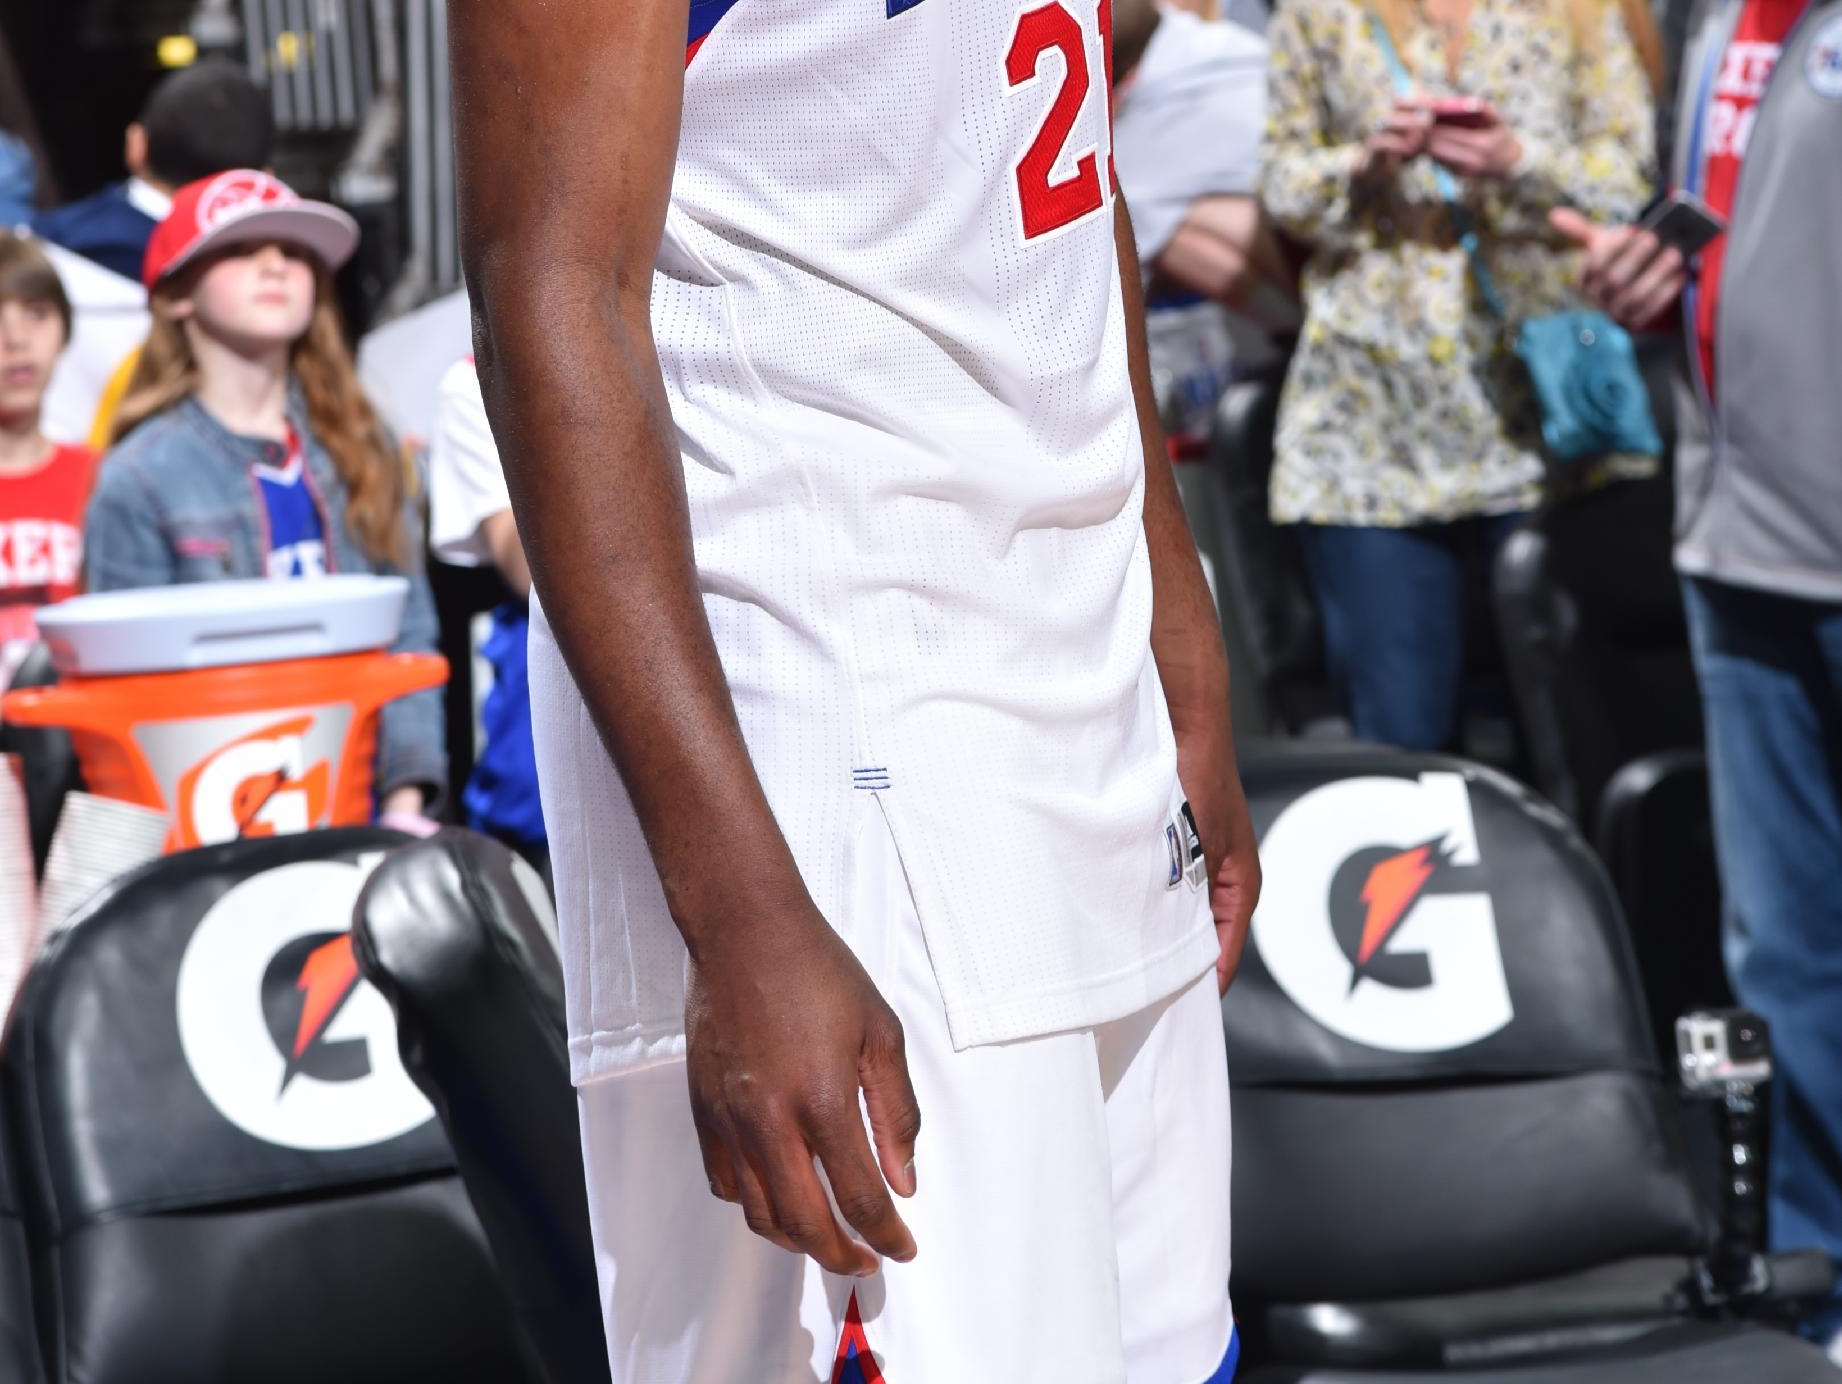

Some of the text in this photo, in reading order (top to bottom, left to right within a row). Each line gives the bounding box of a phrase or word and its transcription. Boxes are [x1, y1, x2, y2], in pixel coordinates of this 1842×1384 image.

[191, 735, 308, 847] G
[1250, 770, 1515, 1053] G
[175, 851, 437, 1151] G
